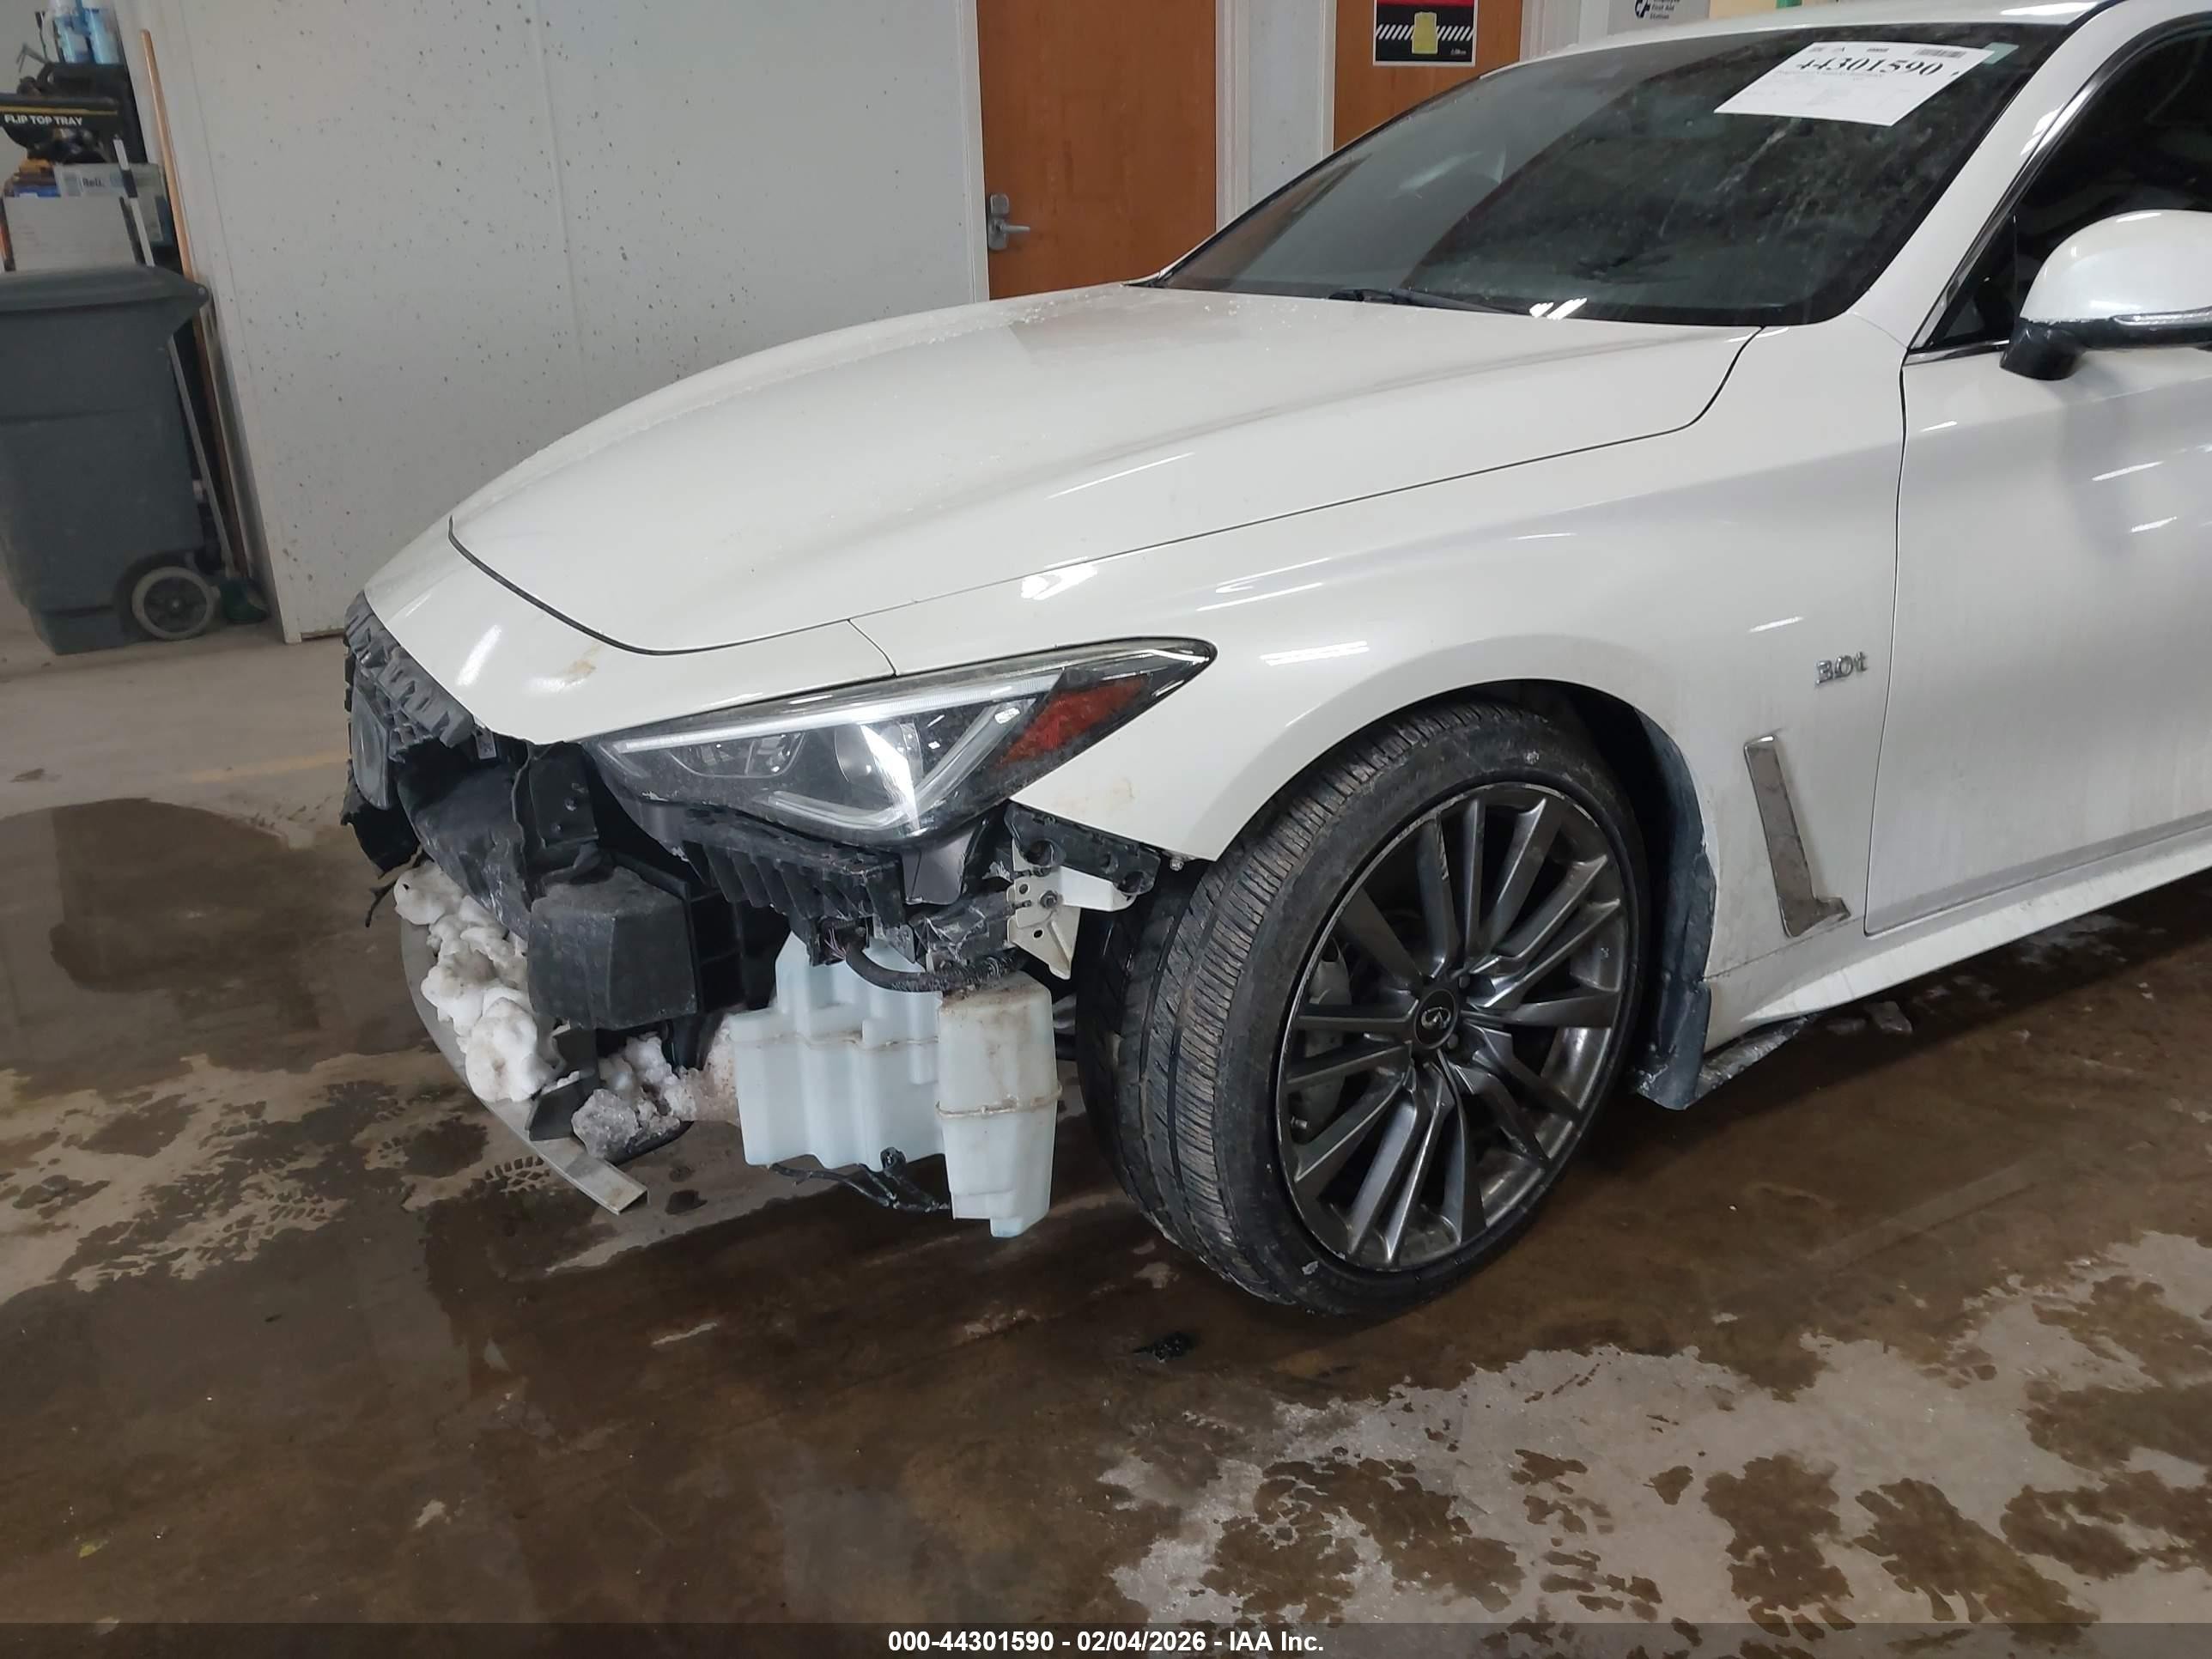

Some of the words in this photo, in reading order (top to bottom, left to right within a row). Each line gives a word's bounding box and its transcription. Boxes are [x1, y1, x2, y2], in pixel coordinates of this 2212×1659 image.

[1797, 57, 1944, 76] 44301590
[4, 114, 28, 124] FLIP
[29, 115, 52, 125] TOP
[52, 116, 82, 125] TRAY
